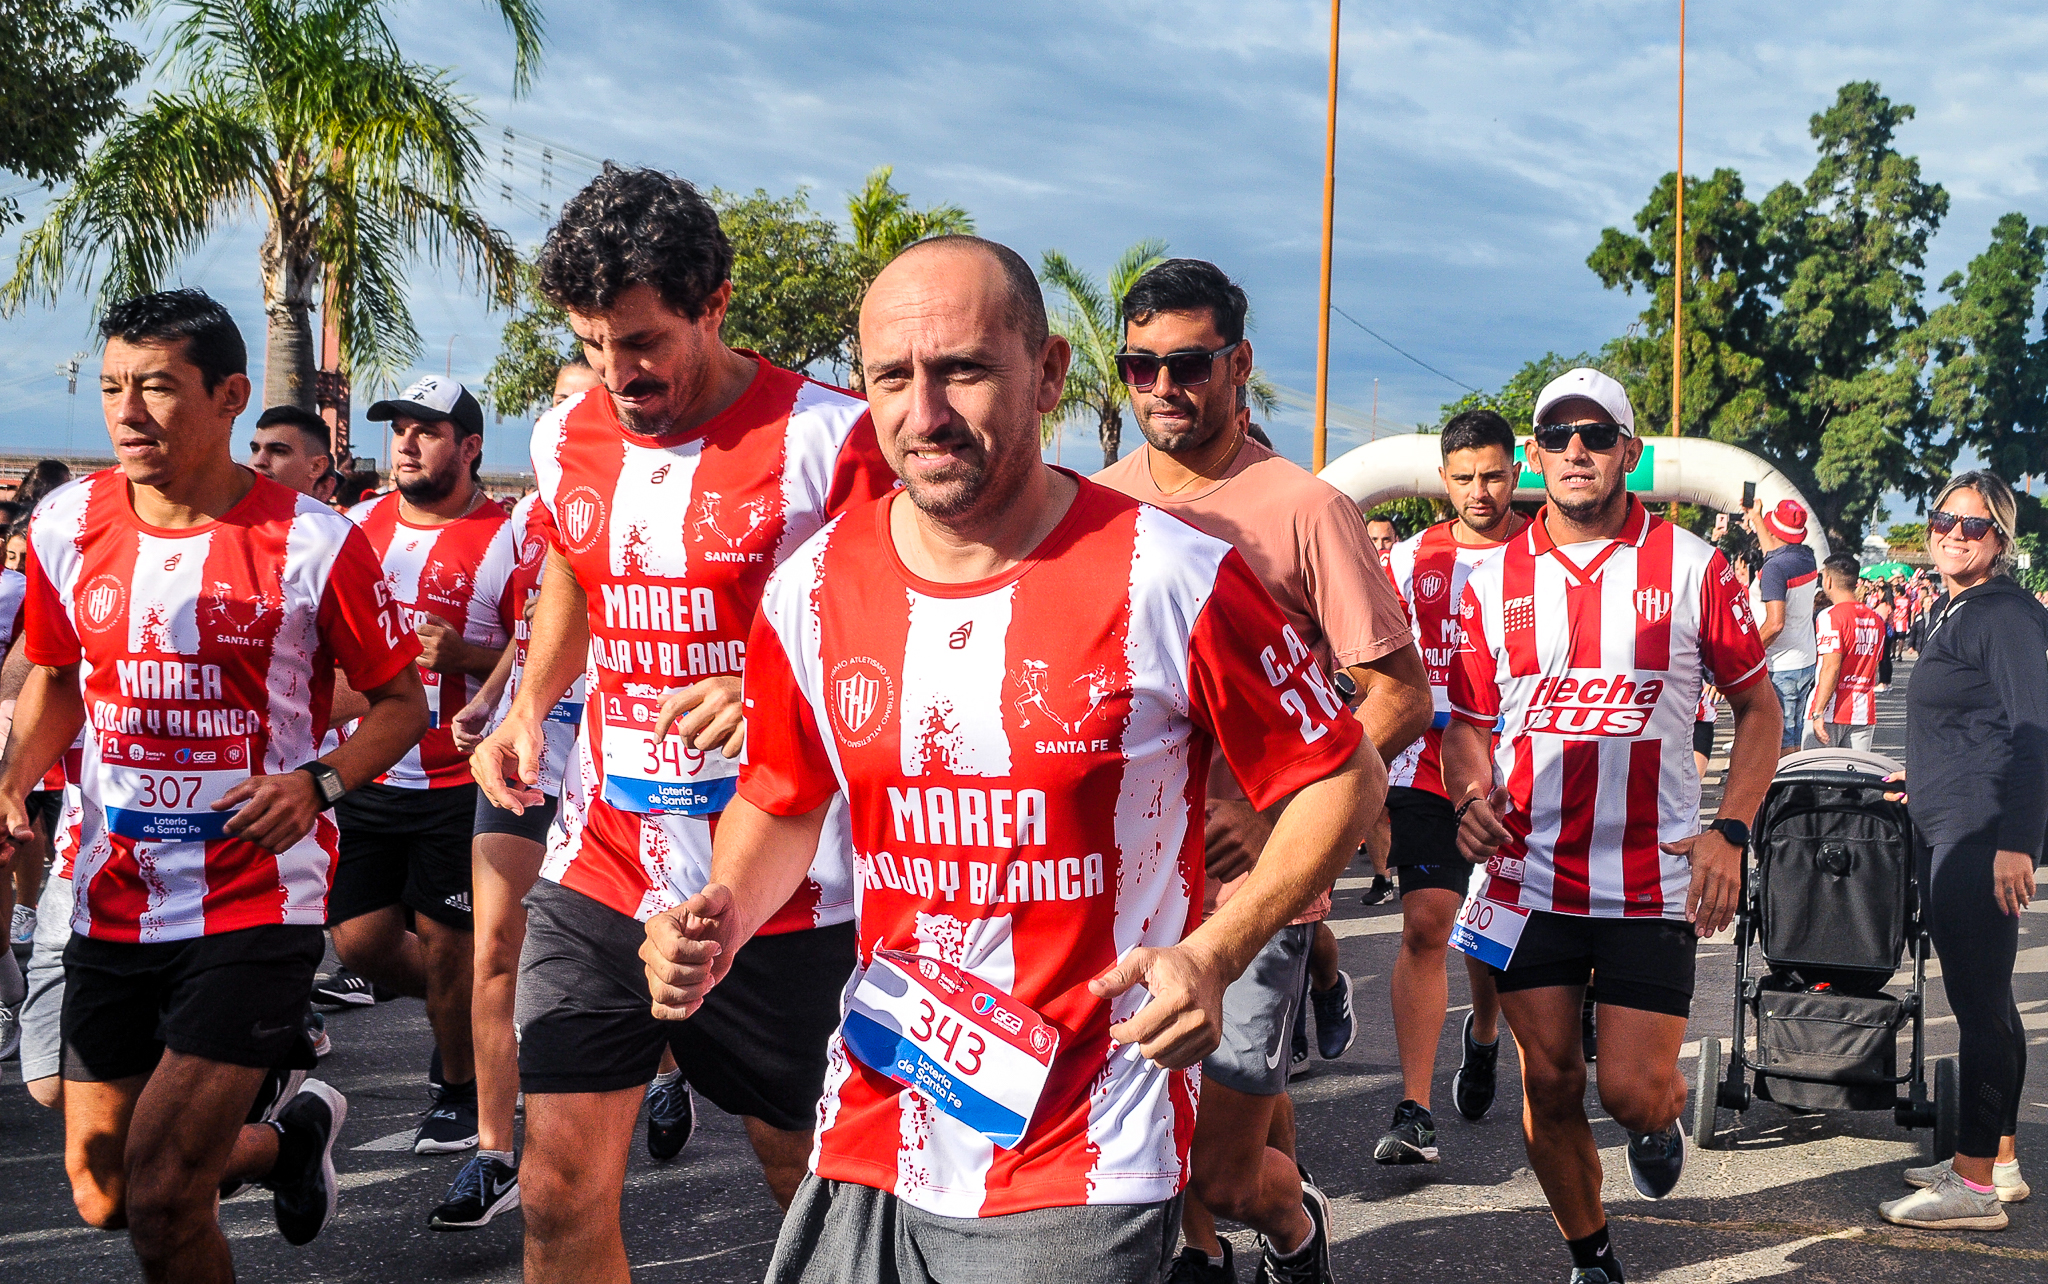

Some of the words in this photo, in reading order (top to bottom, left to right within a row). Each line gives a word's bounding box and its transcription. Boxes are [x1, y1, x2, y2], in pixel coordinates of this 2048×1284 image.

[704, 551, 745, 563] SANTA
[748, 553, 764, 563] FE
[600, 584, 717, 632] MAREA
[217, 634, 250, 646] SANTA
[252, 637, 265, 647] FE
[377, 610, 399, 650] 2
[635, 641, 653, 674] Y
[657, 640, 746, 677] BLANC
[116, 659, 222, 701] MAREA
[1301, 661, 1343, 720] K
[1529, 675, 1664, 707] flecha
[94, 700, 143, 735] ROJA
[147, 709, 162, 736] Y
[166, 708, 261, 738] BLANCA
[1280, 689, 1328, 744] 2
[1528, 709, 1646, 735] BUS
[643, 738, 706, 777] 349
[1035, 740, 1087, 754] SANTA
[1091, 739, 1109, 752] FE
[139, 774, 203, 809] 307
[648, 794, 661, 803] de
[661, 795, 693, 806] Santa
[694, 795, 708, 804] Fe
[143, 825, 155, 833] de
[157, 825, 187, 835] Santa
[189, 826, 201, 834] Fe
[887, 787, 1047, 849] MAREA
[865, 851, 934, 900] ROJA
[939, 860, 960, 902] Y
[968, 852, 1104, 906] BLANCA
[910, 998, 987, 1076] 343
[897, 1058, 915, 1075] de
[915, 1067, 948, 1099] Santa
[946, 1092, 963, 1109] Fe
